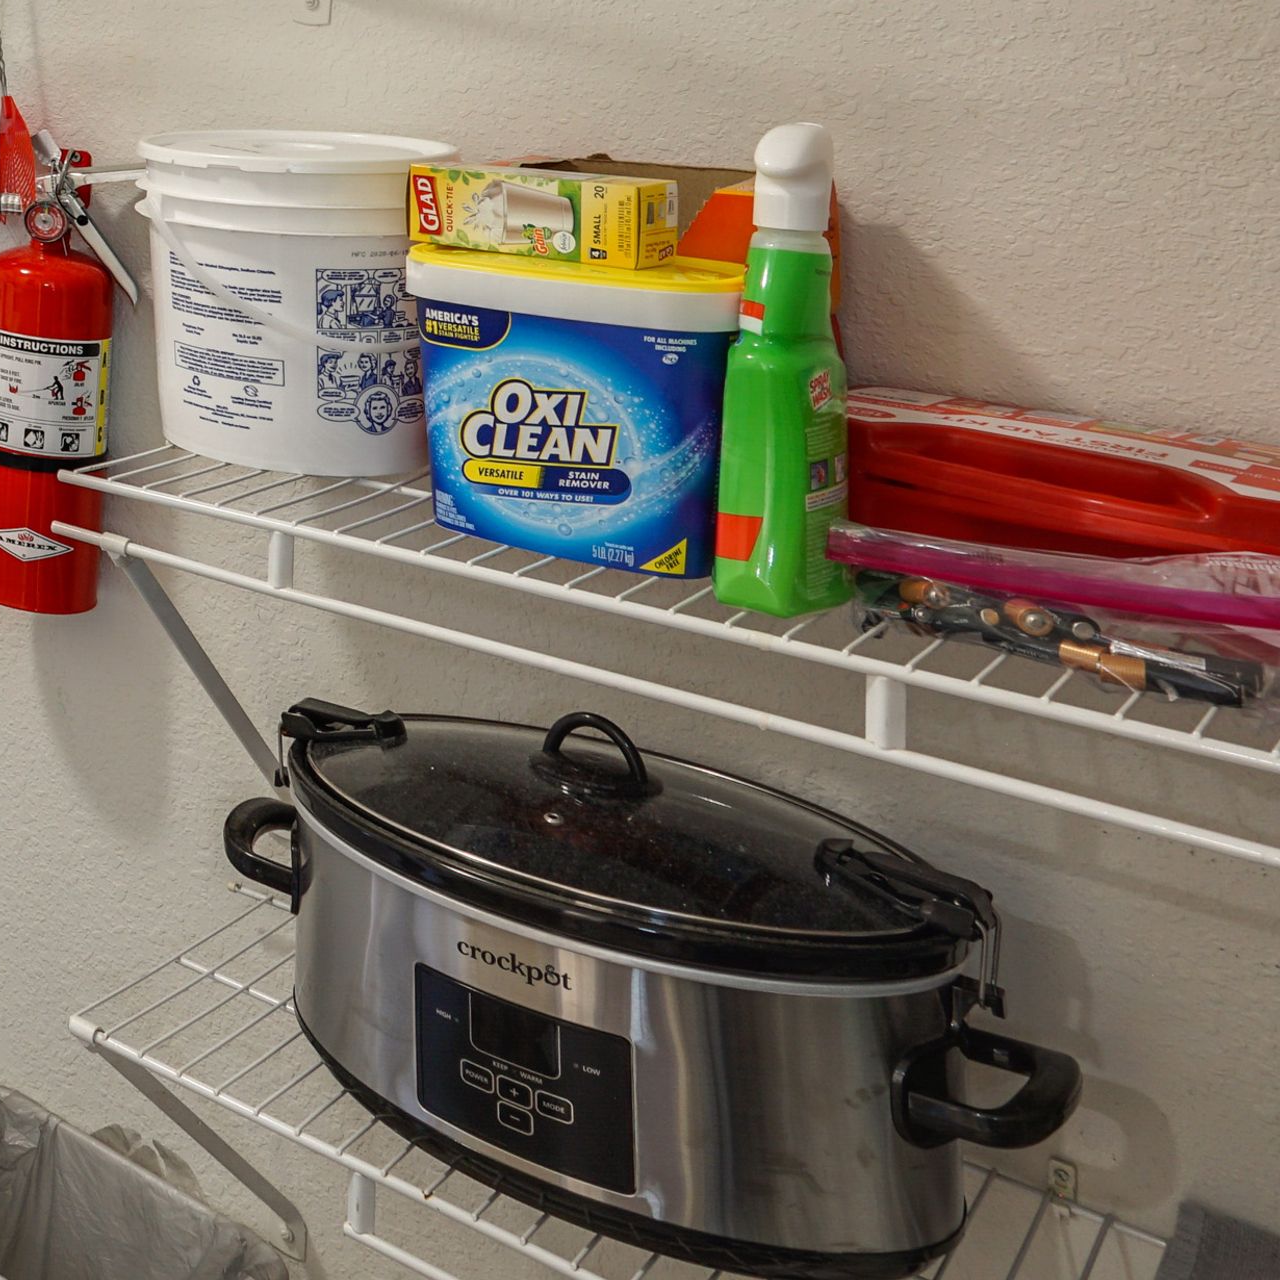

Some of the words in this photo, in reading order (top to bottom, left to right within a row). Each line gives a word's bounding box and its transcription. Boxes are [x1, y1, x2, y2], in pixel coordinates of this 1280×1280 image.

[594, 185, 604, 199] 20
[417, 177, 440, 231] GLAD
[446, 185, 454, 232] QUICK-TIE
[593, 214, 601, 245] SMALL
[533, 228, 549, 256] Gain
[591, 251, 599, 259] 4
[425, 308, 479, 326] AMERICA'S
[425, 319, 438, 335] #1
[439, 322, 479, 335] VERSATILE
[439, 329, 453, 337] STAIN
[0, 335, 83, 355] INSTRUCTIONS
[655, 344, 687, 352] INCLUDING
[810, 370, 829, 390] SPRAY
[494, 381, 581, 426] OXI
[812, 391, 832, 408] WASH
[463, 412, 613, 464] CLEAN
[997, 425, 1059, 437] AID
[478, 467, 524, 480] VERSATILE
[568, 471, 600, 480] STAIN
[558, 478, 610, 490] REMOVER
[498, 488, 519, 496] OVER
[521, 490, 534, 498] 101
[536, 492, 559, 501] WAYS
[575, 495, 593, 503] USE!
[592, 545, 597, 557] 5
[654, 548, 682, 569] CHLORINE
[666, 559, 681, 571] FREE
[456, 939, 573, 992] crockpot
[436, 1008, 452, 1020] HIGH
[464, 1068, 490, 1085] POWER
[492, 1060, 509, 1072] KEEP
[520, 1069, 544, 1085] WARM
[582, 1064, 601, 1077] LOW
[542, 1100, 566, 1114] MODE
